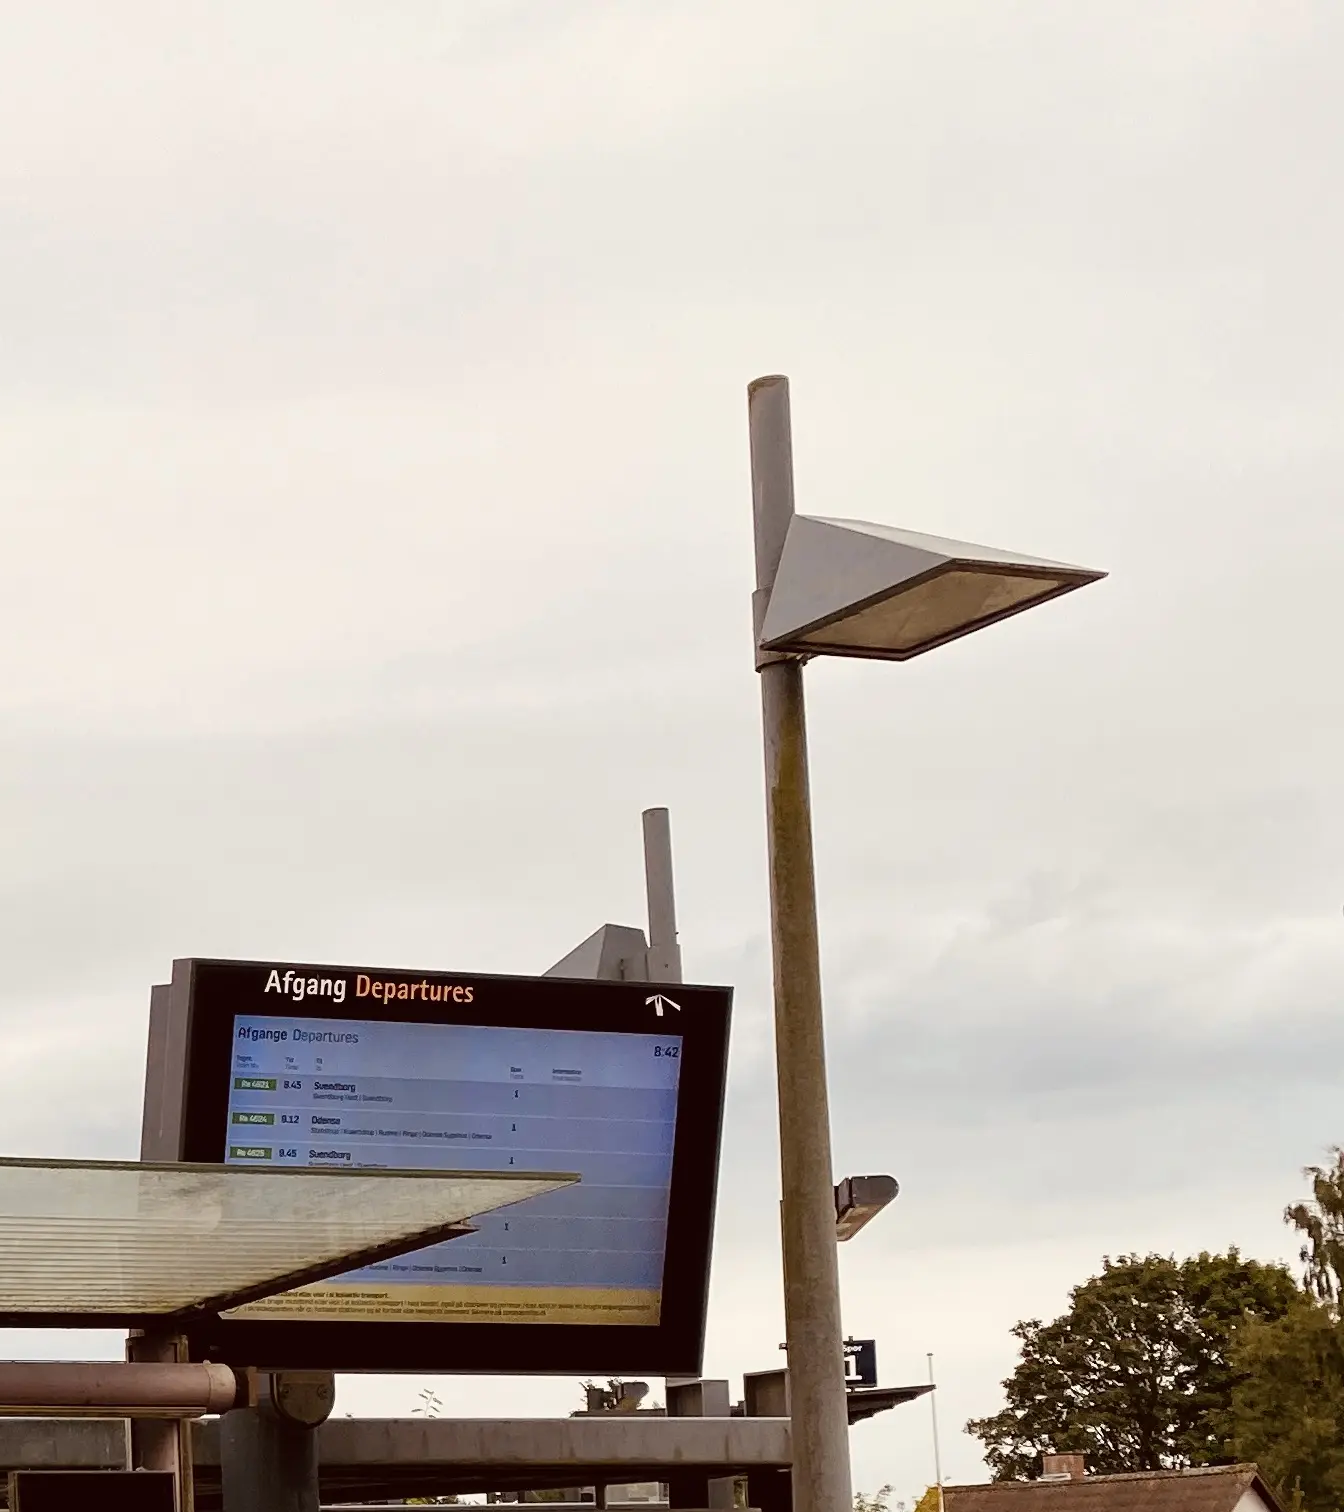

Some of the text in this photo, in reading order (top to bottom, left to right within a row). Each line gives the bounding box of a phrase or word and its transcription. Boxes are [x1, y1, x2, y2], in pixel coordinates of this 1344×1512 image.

[264, 969, 474, 1004] Afgang Departures
[238, 1026, 359, 1044] Afgange Departures
[514, 1089, 519, 1098] 1
[511, 1123, 517, 1132] 1
[844, 1355, 862, 1380] 1
